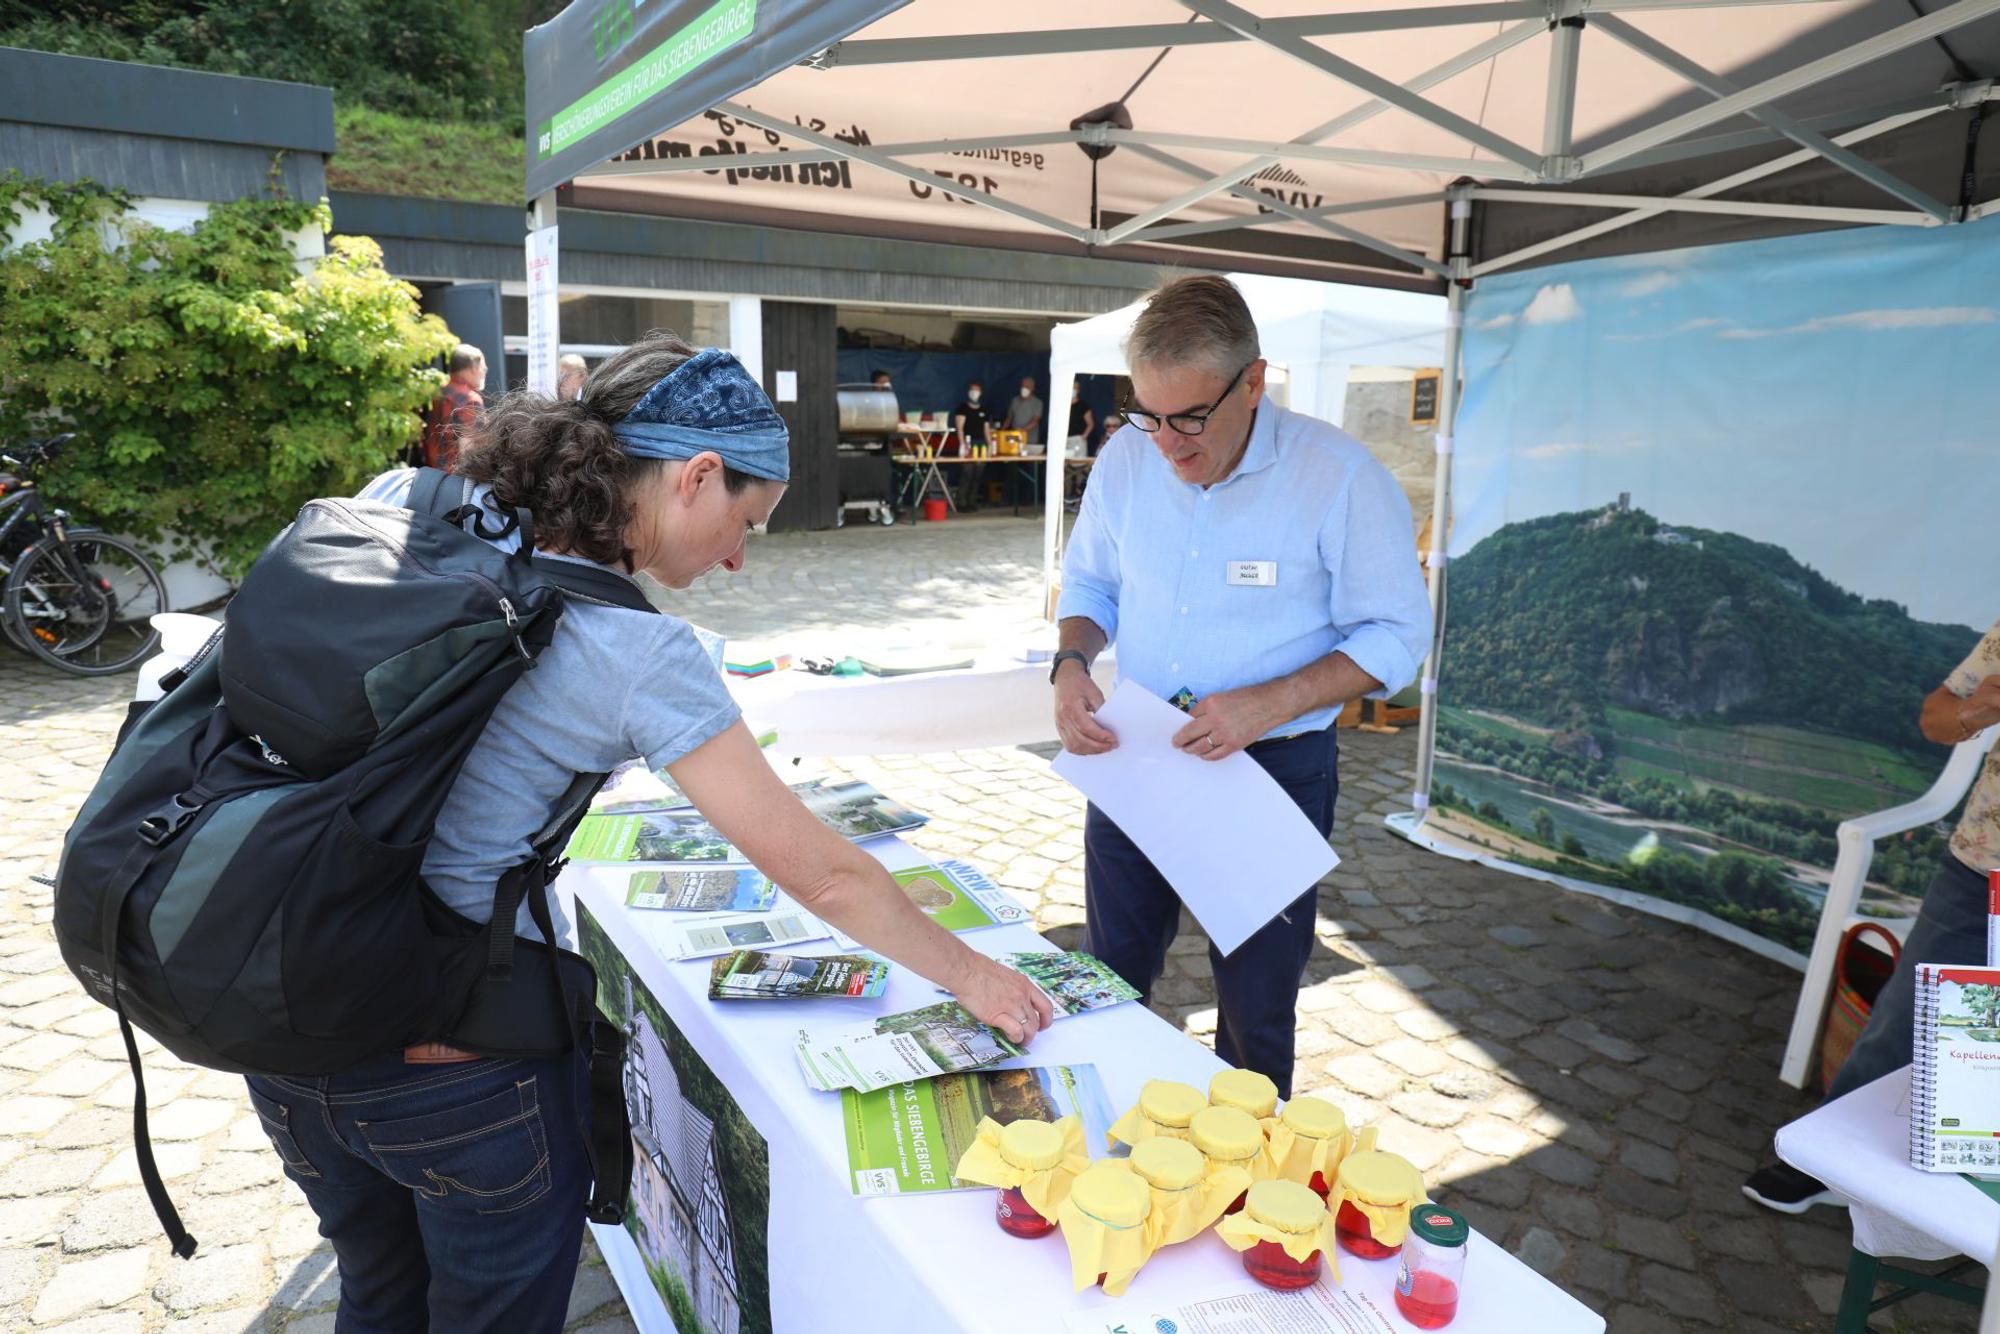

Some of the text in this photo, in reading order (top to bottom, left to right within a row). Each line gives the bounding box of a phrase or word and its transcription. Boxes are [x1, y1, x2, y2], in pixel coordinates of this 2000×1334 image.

[552, 3, 751, 145] VERSCHÖNERUNGSVEREIN FÜR DAS SIEBENGEBIRGE
[874, 1171, 886, 1189] VVS
[902, 1080, 936, 1185] DAS SIEBENGEBIRGE
